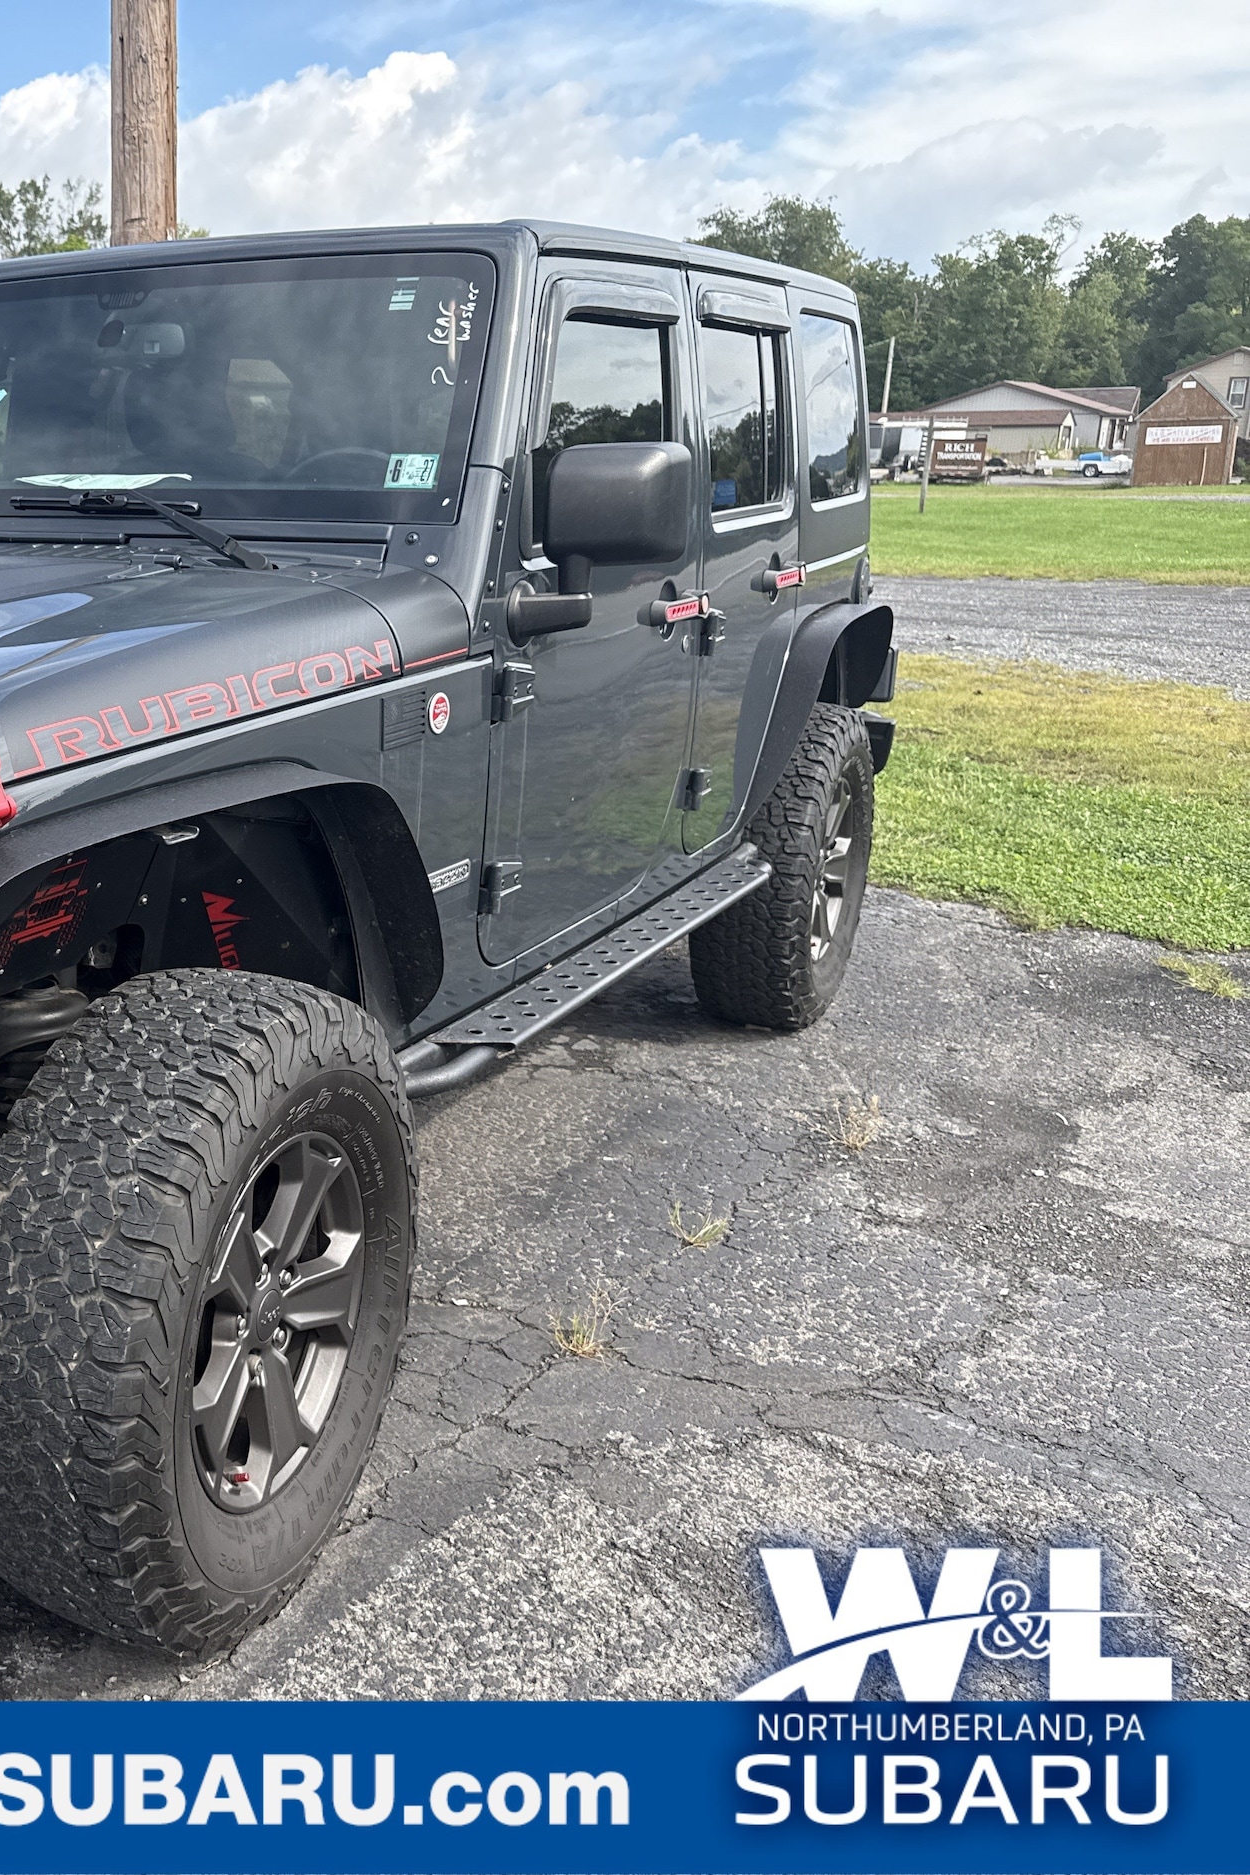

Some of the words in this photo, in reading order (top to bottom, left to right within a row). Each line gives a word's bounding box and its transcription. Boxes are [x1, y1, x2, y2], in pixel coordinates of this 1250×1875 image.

[428, 300, 452, 345] rear
[936, 451, 982, 461] TRANSPORTATION
[944, 442, 975, 452] RICH
[391, 459, 403, 482] 6
[420, 459, 434, 482] 27
[14, 639, 401, 777] RUBICON
